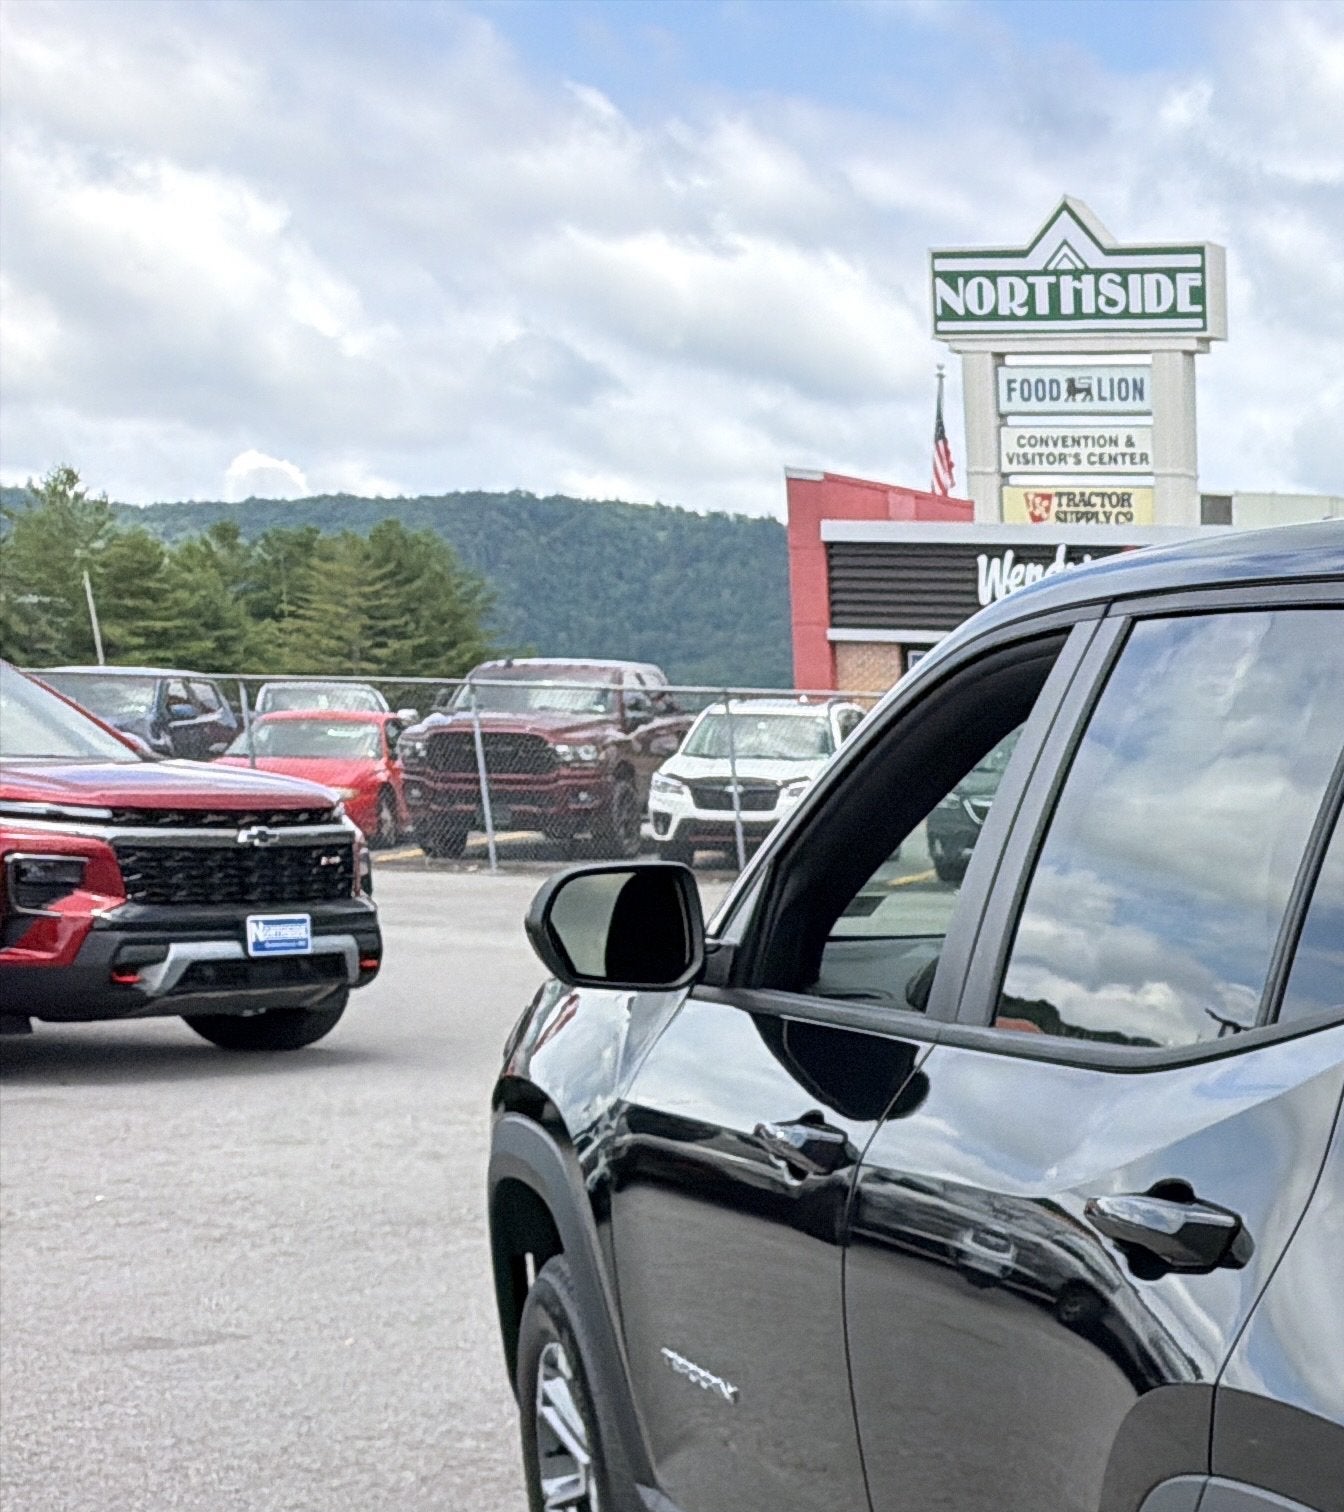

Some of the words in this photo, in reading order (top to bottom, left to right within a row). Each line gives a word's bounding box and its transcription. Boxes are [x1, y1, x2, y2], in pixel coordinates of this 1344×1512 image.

[934, 272, 1203, 317] NORTHSIDE
[1006, 377, 1061, 402] FOOD
[1097, 376, 1145, 402] LION
[1016, 434, 1119, 449] CONVENTION
[1124, 434, 1136, 448] &
[1005, 451, 1082, 466] VISITOR'S
[1086, 451, 1150, 466] CENTER
[1055, 491, 1133, 508] TRACTOR
